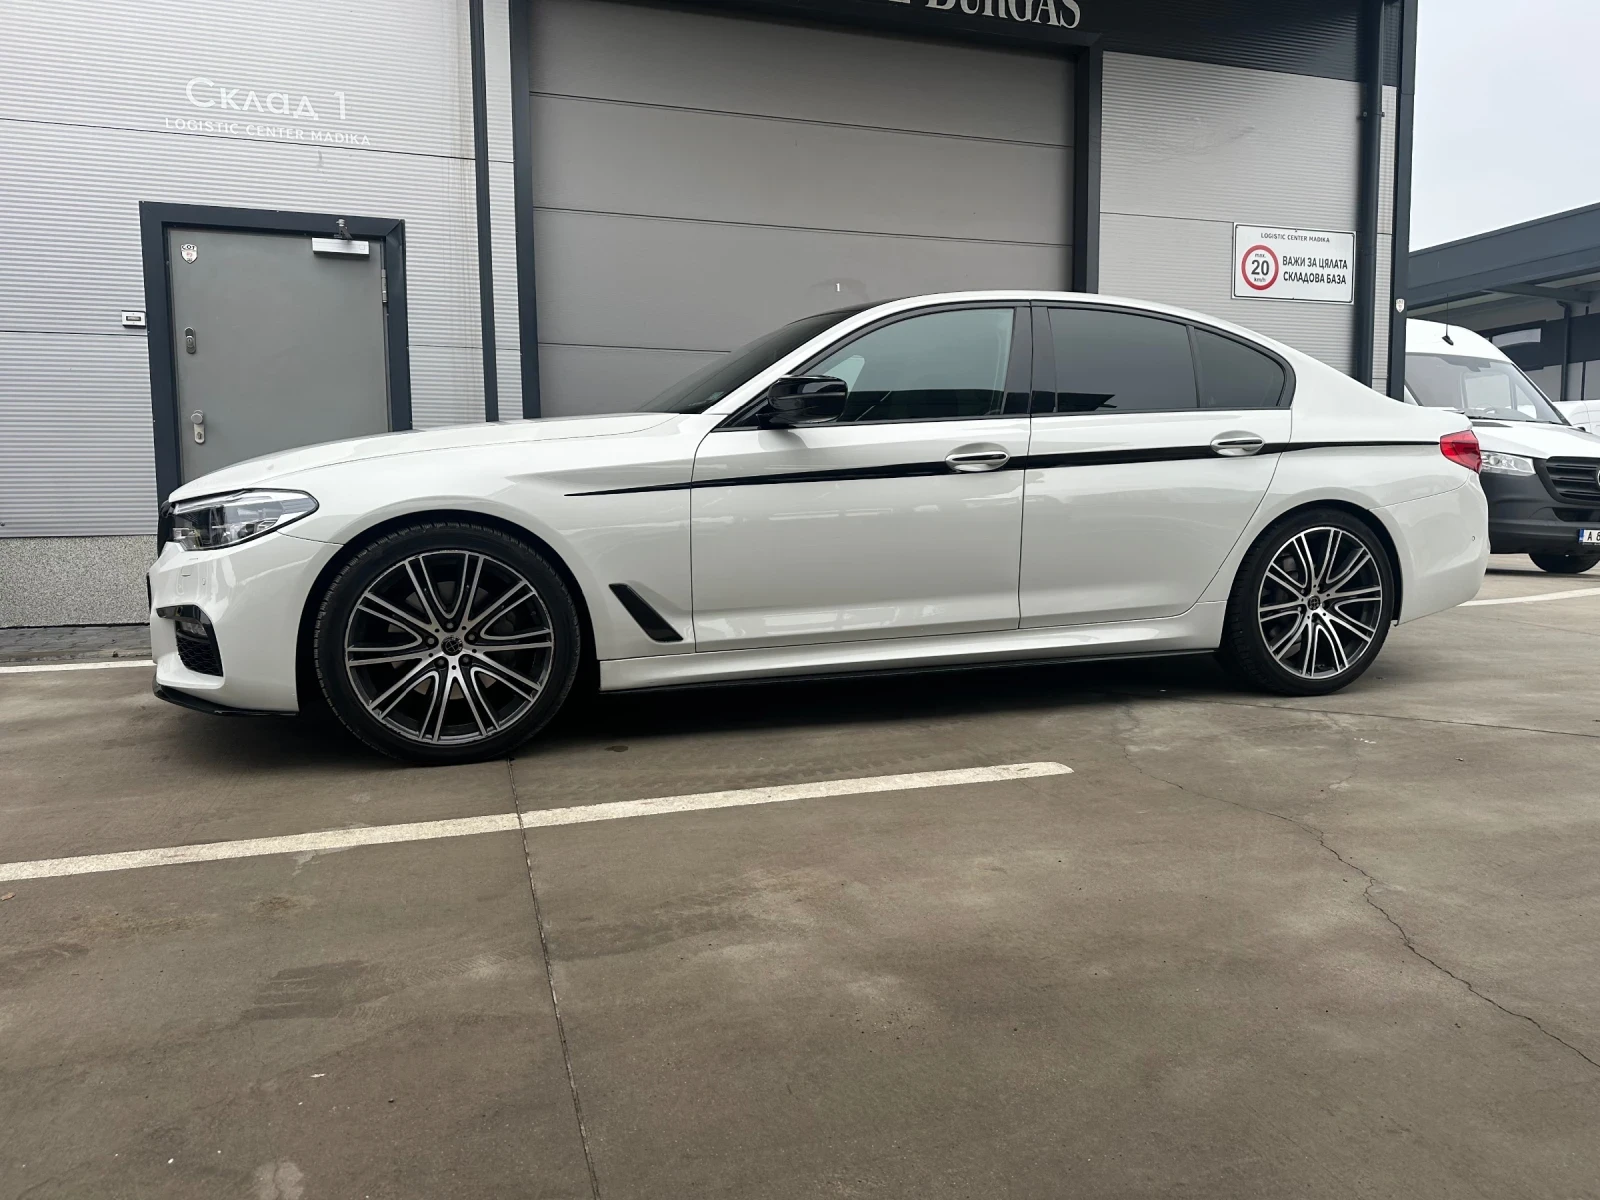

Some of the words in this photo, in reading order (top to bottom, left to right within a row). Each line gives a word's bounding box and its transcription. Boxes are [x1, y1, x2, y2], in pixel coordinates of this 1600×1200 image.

[925, 0, 1081, 29] GAS
[185, 76, 320, 121] Склад
[332, 91, 347, 120] 1
[164, 117, 240, 135] LOGISTIC
[245, 124, 305, 140] CENTER
[310, 130, 372, 146] MADIKA
[1260, 232, 1286, 241] LOGISTIC
[1287, 234, 1308, 242] CENTER
[1309, 235, 1330, 243] MADIKA
[1251, 259, 1270, 276] 20
[1282, 255, 1306, 267] ВАЖИ
[1307, 256, 1318, 268] ЗА
[1318, 258, 1348, 270] ЦЯЛАТА
[1283, 271, 1326, 285] СКЛАДОВА
[1326, 273, 1347, 285] БАЗА
[1587, 531, 1593, 541] A
